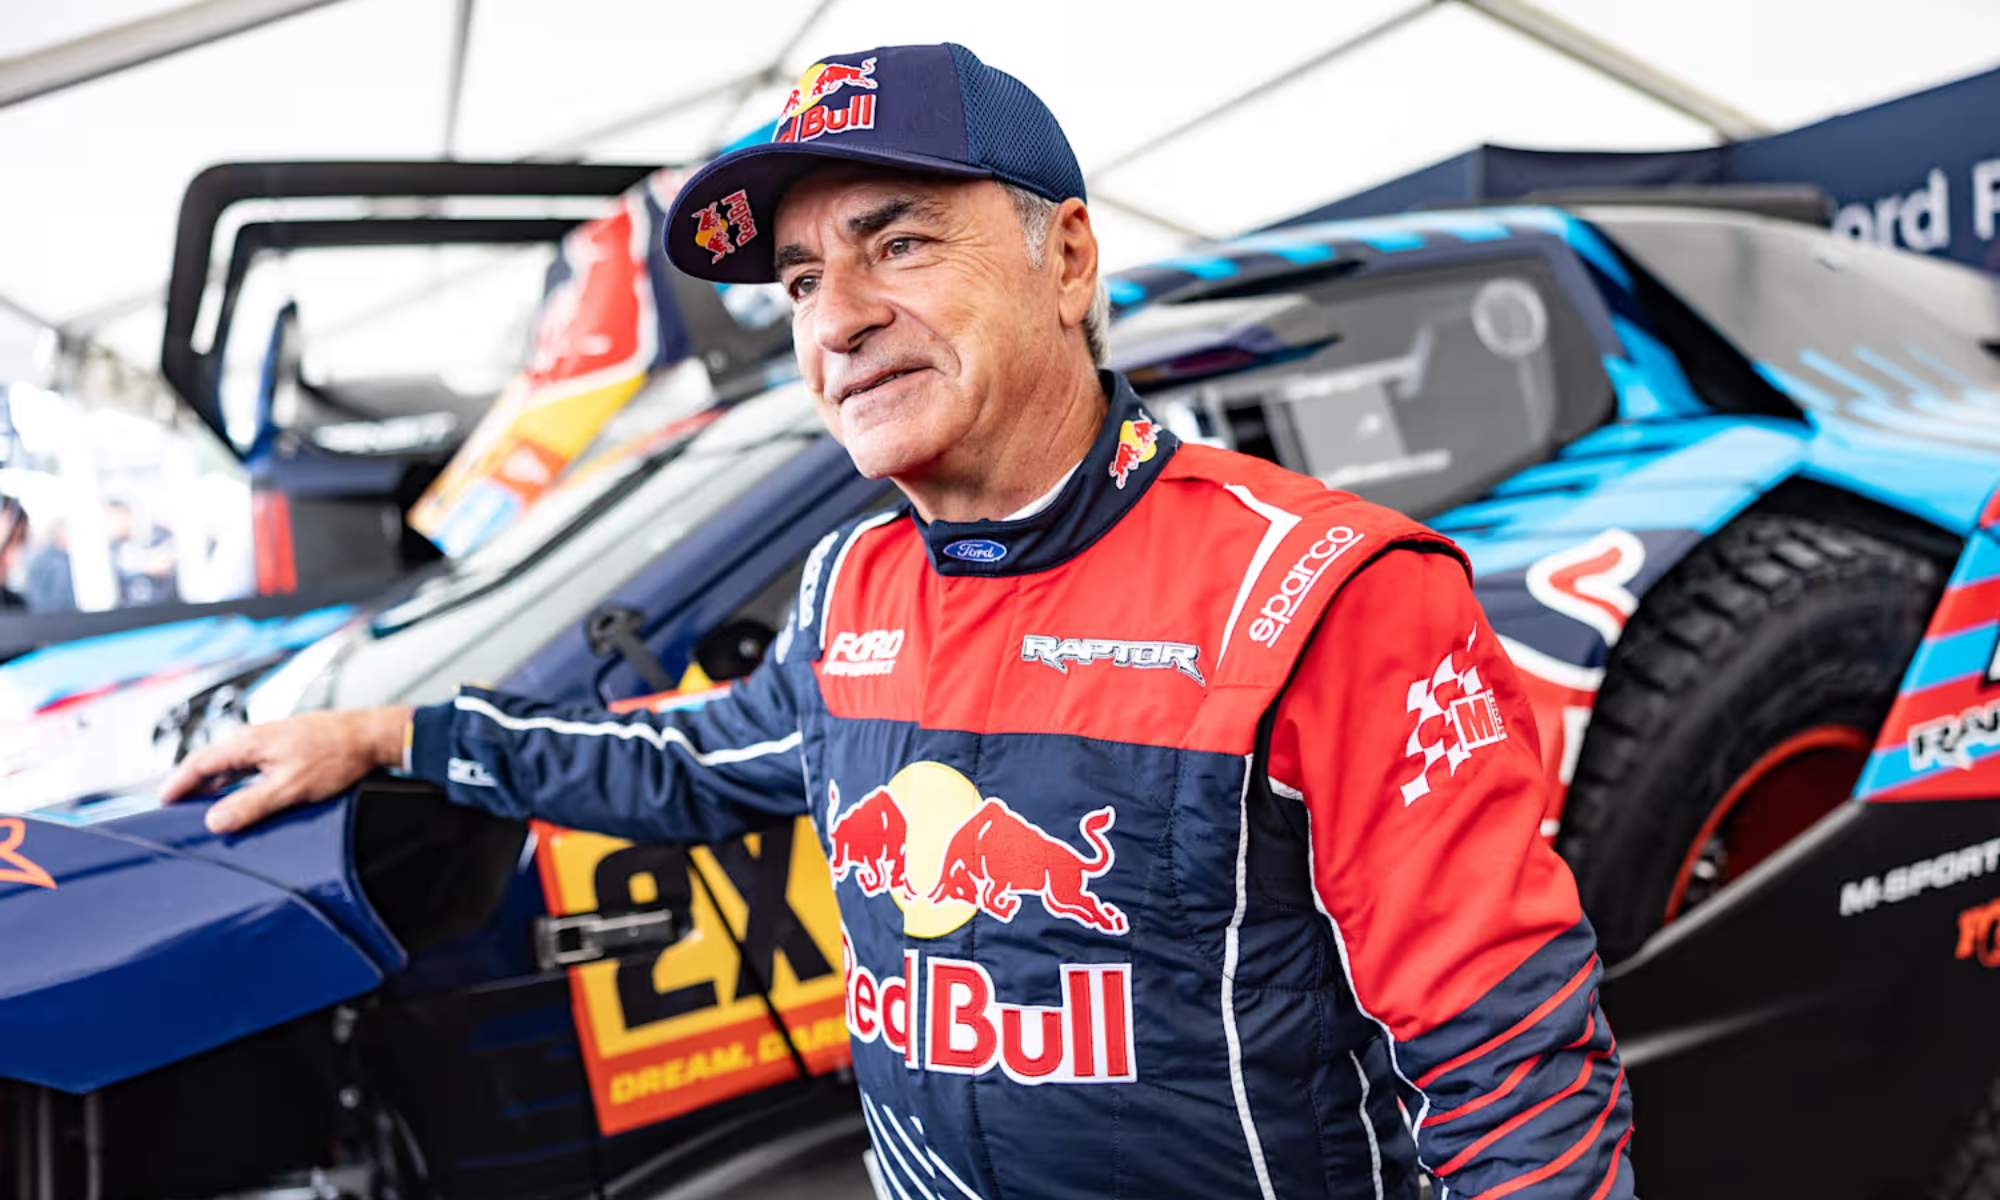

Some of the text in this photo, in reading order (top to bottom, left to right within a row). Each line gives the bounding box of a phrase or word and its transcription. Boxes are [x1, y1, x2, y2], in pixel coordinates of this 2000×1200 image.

[801, 93, 876, 142] Bull
[1833, 167, 1949, 252] ord
[957, 543, 995, 558] Ford
[1248, 525, 1355, 643] sparco
[830, 629, 904, 662] FORD
[1021, 635, 1206, 687] RAPTOR
[842, 930, 1137, 1085] ed Bull
[610, 1041, 754, 1106] DREAM.
